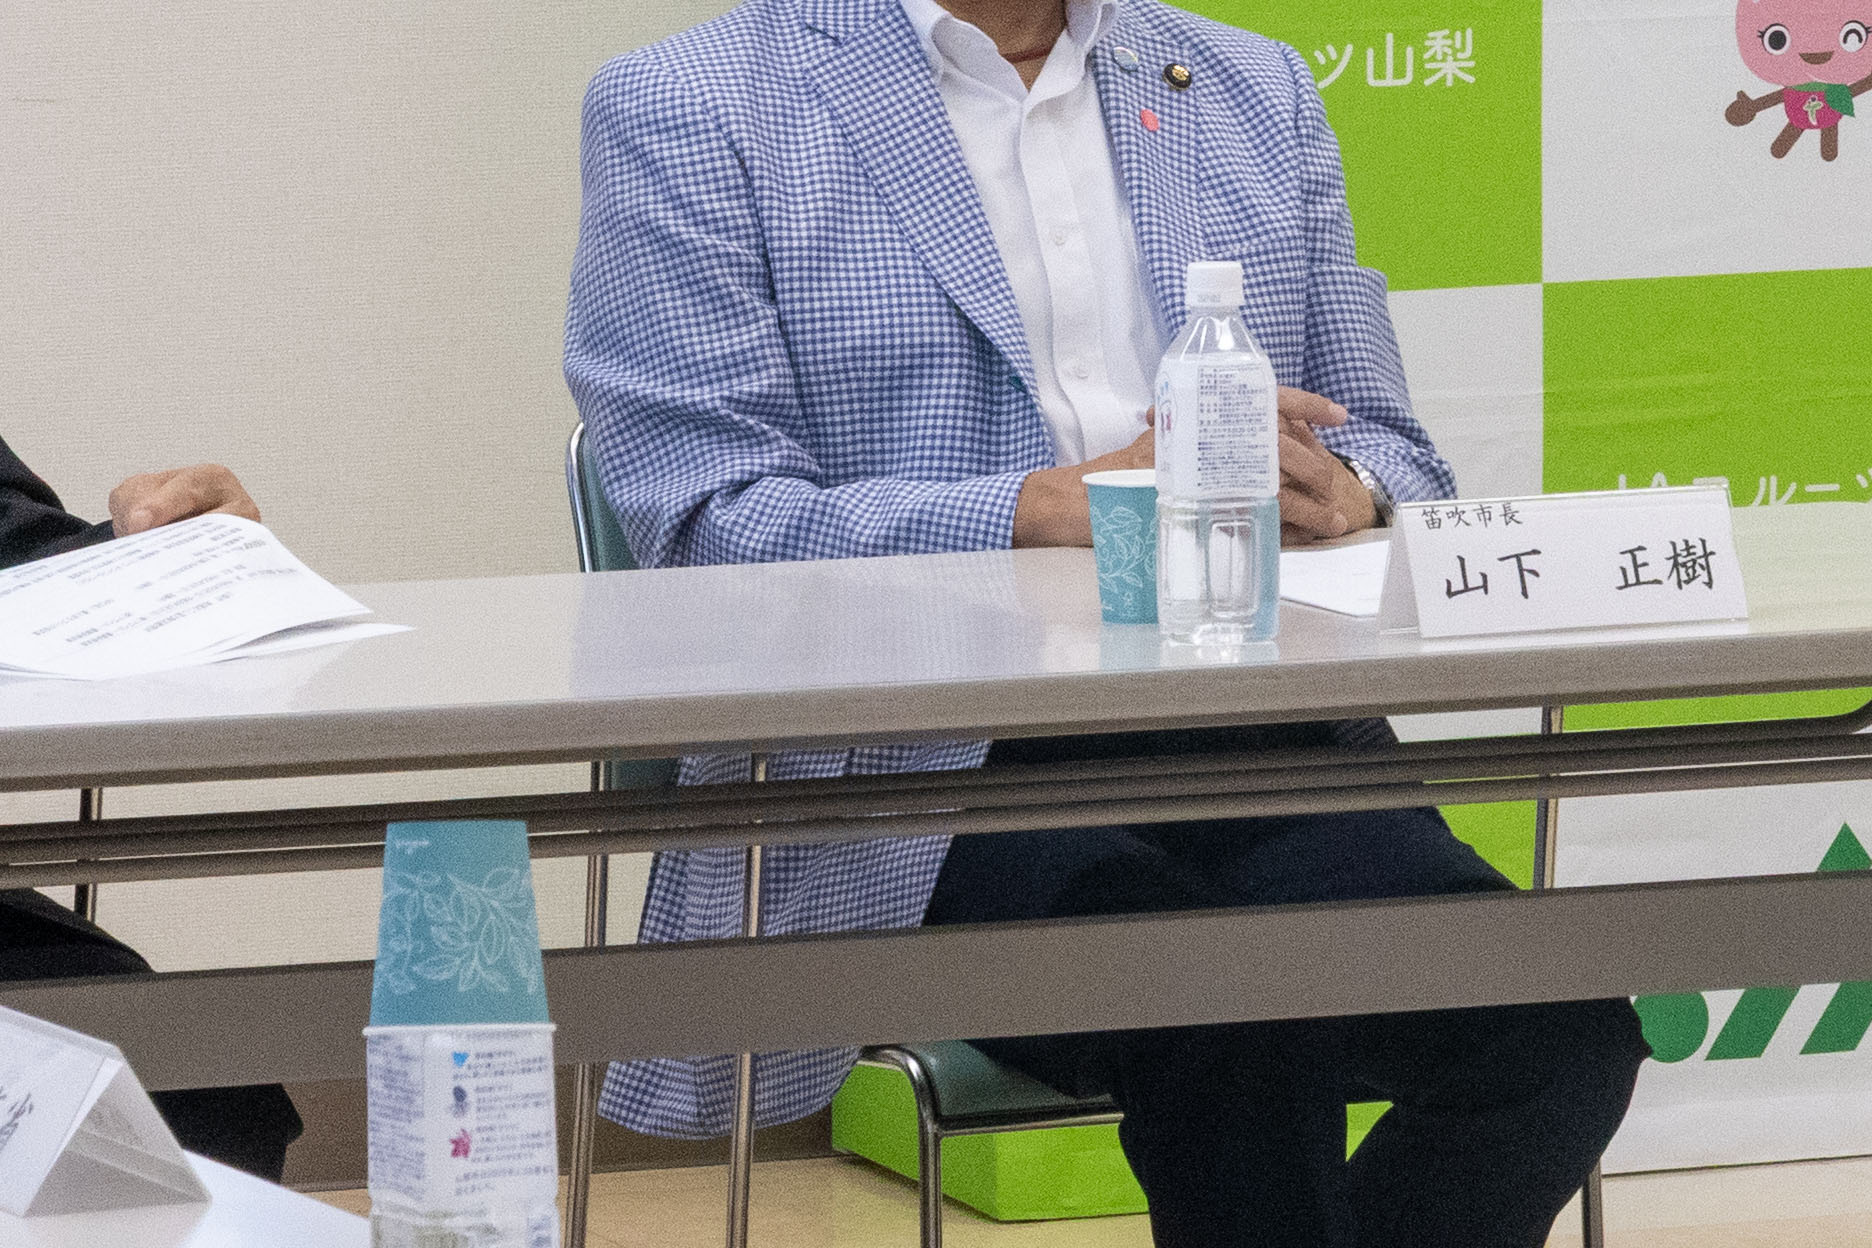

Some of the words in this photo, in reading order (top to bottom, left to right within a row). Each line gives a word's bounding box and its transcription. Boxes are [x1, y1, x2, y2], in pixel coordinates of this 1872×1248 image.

[1314, 27, 1476, 89] ツ山梨
[1421, 501, 1524, 530] 笛吹市長
[1445, 549, 1542, 599] 山下
[1616, 537, 1717, 590] 正樹
